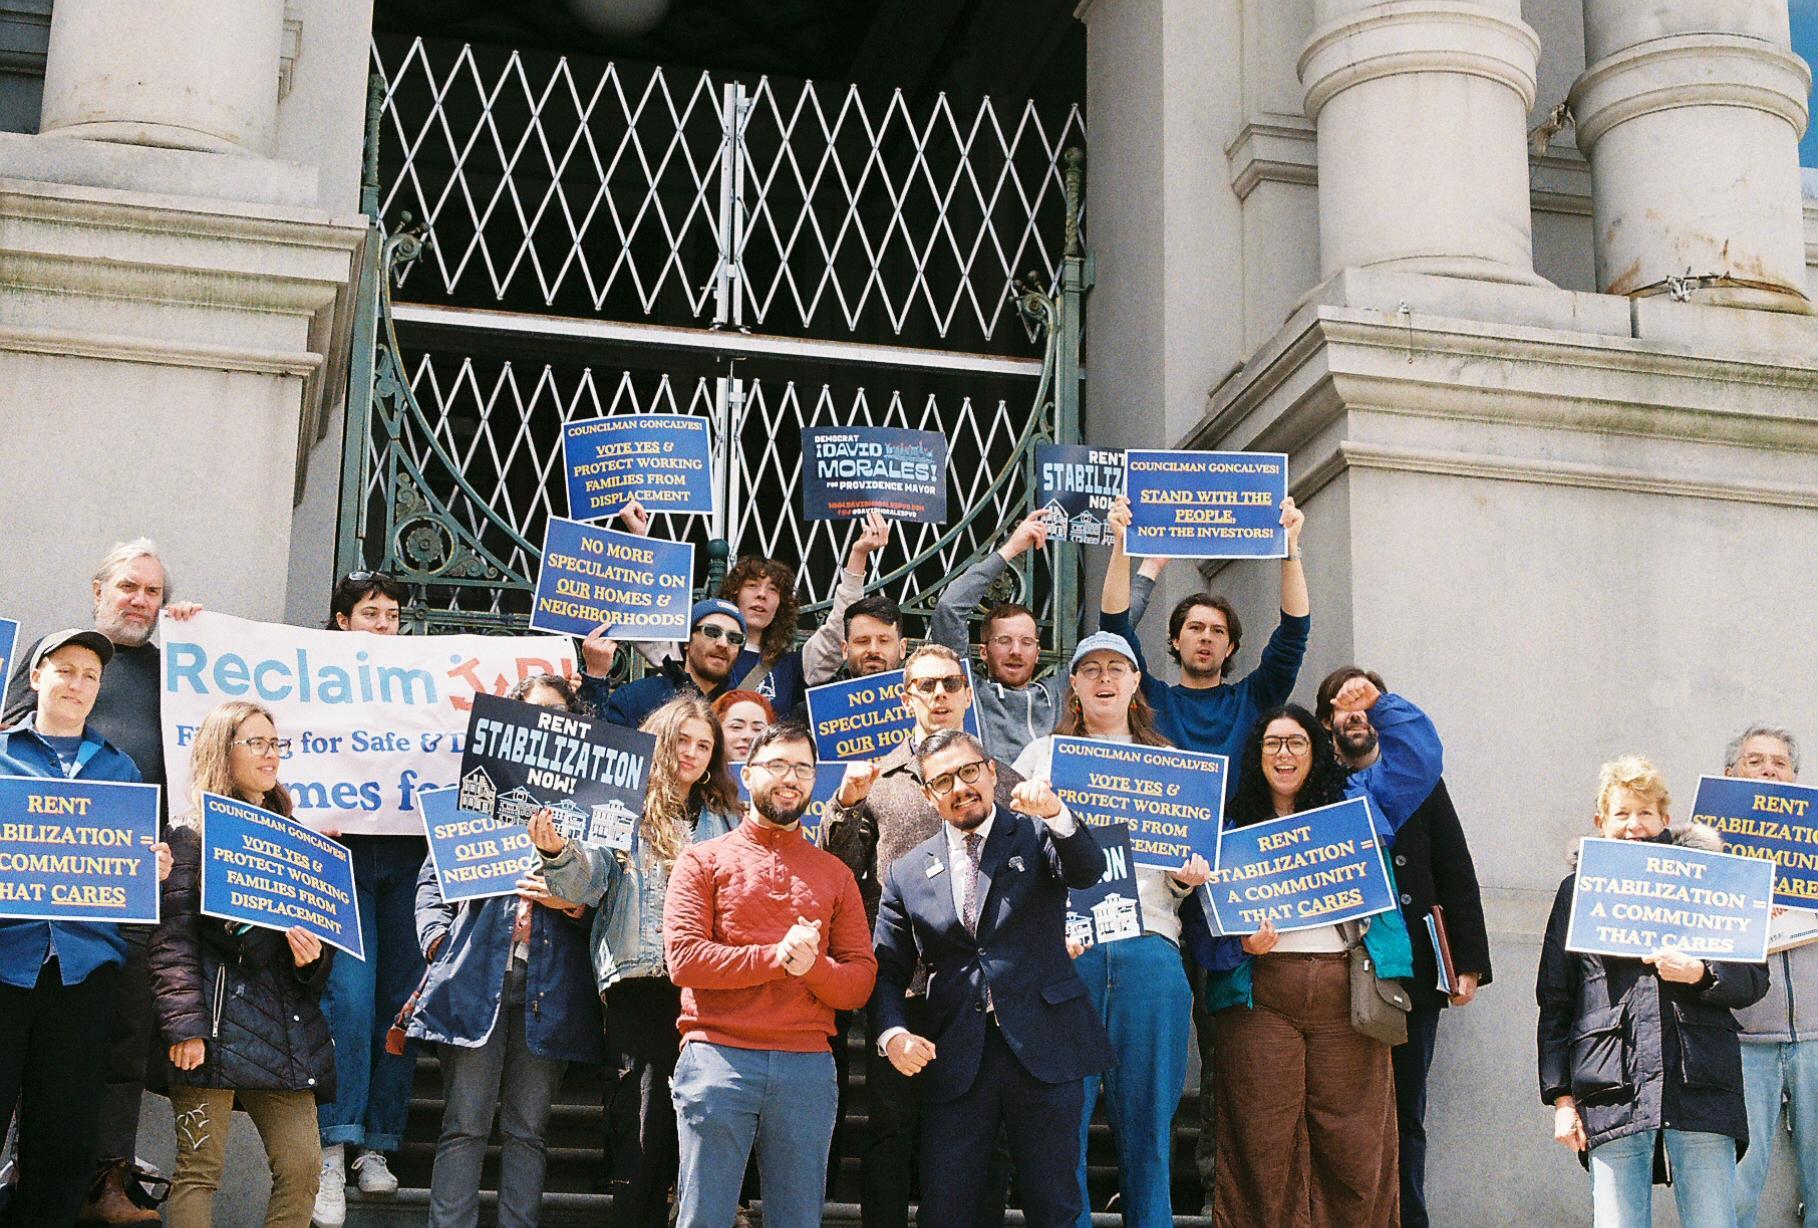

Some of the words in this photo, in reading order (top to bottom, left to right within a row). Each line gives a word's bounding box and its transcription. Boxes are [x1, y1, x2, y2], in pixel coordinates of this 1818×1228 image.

[568, 421, 637, 436] COUNCILMAN
[640, 420, 702, 430] GONCALVES!
[815, 435, 859, 443] DEMOCRAT
[596, 443, 632, 457] VOTE
[635, 441, 660, 454] YES
[663, 442, 674, 452] &
[1089, 450, 1125, 466] RENT
[574, 459, 633, 477] PROTECT
[638, 458, 702, 469] WORKING
[818, 459, 937, 482] MORALES!
[1043, 463, 1124, 495] STABILIZ
[1130, 461, 1206, 473] COUNCILMAN
[1209, 463, 1279, 474] GONCALVES!
[586, 475, 644, 491] FAMILIES
[648, 475, 686, 485] FROM
[840, 480, 903, 490] PROVIDENCE
[905, 482, 936, 494] MAYOR
[591, 490, 690, 508] DISPLACEMENT
[1141, 490, 1194, 504] STAND
[1197, 491, 1238, 504] WITH
[1241, 492, 1272, 505] THE
[1175, 510, 1236, 523] PEOPLE,
[1138, 527, 1165, 536] NOT
[1170, 527, 1195, 537] THE
[1198, 528, 1273, 538] INVESTORS!
[581, 537, 603, 554] NO
[607, 543, 654, 564] MORE
[548, 553, 655, 585] SPECULATING
[659, 575, 685, 588] ON
[556, 579, 590, 599] OUR
[594, 586, 652, 606] HOMES
[657, 595, 671, 606] &
[539, 598, 685, 625] NEIGHBORHOODS
[166, 641, 438, 705] Reclaim
[848, 690, 875, 707] NO
[878, 684, 904, 700] MO
[538, 712, 592, 739] RENT
[819, 706, 916, 736] SPECULATI
[301, 731, 342, 754] for
[352, 730, 410, 754] Safe
[421, 733, 443, 752] &
[472, 718, 644, 790] STABILIZATION
[836, 736, 875, 757] OUR
[1058, 744, 1141, 762] COUNCILMAN
[1144, 754, 1219, 772] GONCALVES!
[527, 768, 577, 795] NOW!
[1087, 773, 1130, 791] VOTE
[1133, 780, 1163, 796] YES
[1167, 784, 1180, 795] &
[27, 795, 92, 815] RENT
[288, 781, 382, 811] mes
[1058, 789, 1129, 809] PROTECT
[1134, 799, 1211, 820] WORKING
[1752, 794, 1809, 816] RENT
[0, 824, 133, 847] BILIZATION
[209, 801, 286, 833] COUNCILMAN
[288, 826, 347, 862] GONCALVES!
[434, 818, 513, 839] SPECUL
[1073, 811, 1138, 831] AMILS
[1142, 821, 1188, 837] FROM
[455, 841, 499, 861] OUR
[501, 834, 531, 851] HO
[1131, 839, 1191, 858] EMENT
[1257, 826, 1311, 852] RENT
[0, 854, 141, 876] COMMUNITY
[242, 835, 281, 857] VOTE
[284, 848, 310, 870] YES
[313, 862, 323, 872] &
[1208, 840, 1355, 884] STABILIZATION
[1360, 839, 1374, 849] =
[214, 847, 284, 876] PROTECT
[288, 867, 350, 904] WORKING
[443, 856, 532, 883] NEIGHBO
[1646, 857, 1707, 879] RENT
[0, 883, 46, 901] HAT
[51, 885, 126, 907] CARES
[227, 870, 296, 898] FAMILIES
[299, 889, 337, 915] FROM
[1227, 890, 1246, 903] A
[1245, 862, 1367, 900] COMMUNITY
[1579, 876, 1746, 909] STABILIZATION
[1753, 900, 1767, 909] =
[1774, 877, 1818, 899] ARE
[231, 892, 342, 934] DISPLACEMENT
[1239, 904, 1292, 922] THAT
[1298, 888, 1364, 918] CARES
[1590, 902, 1606, 918] A
[1612, 904, 1751, 932] COMMUNITY
[1596, 927, 1656, 946] THAT
[1661, 934, 1734, 953] CARES
